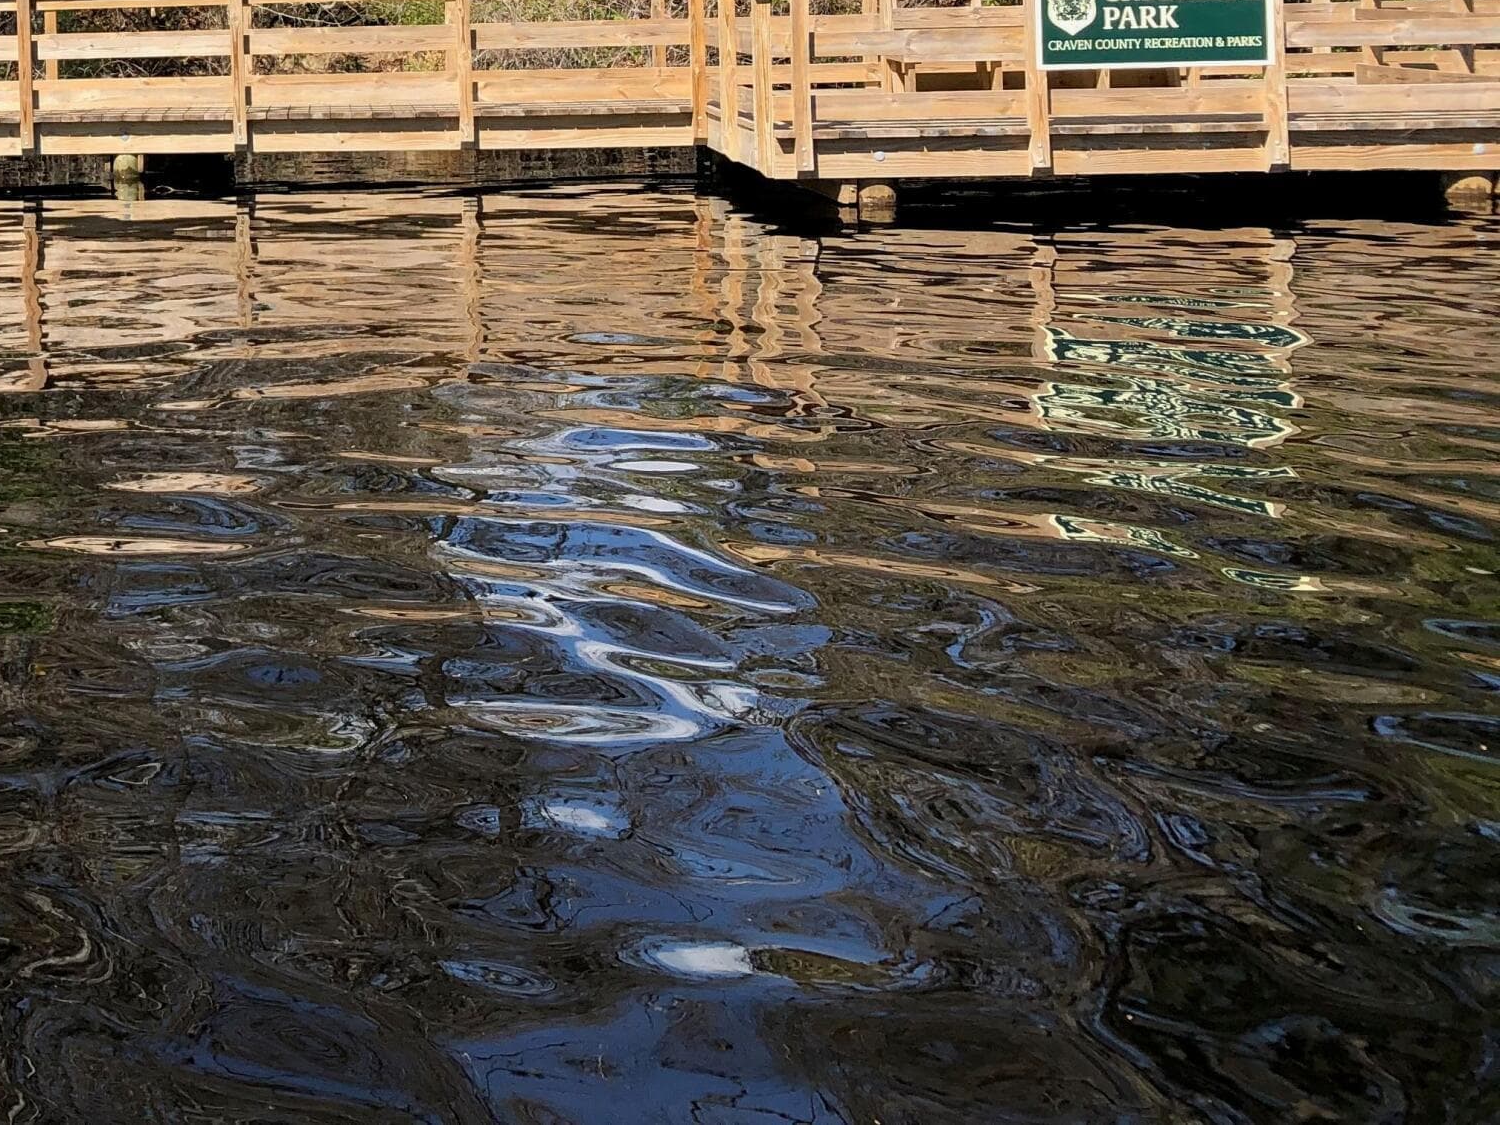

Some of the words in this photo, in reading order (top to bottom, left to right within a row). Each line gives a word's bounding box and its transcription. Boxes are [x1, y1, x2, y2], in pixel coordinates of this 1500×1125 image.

[1102, 5, 1179, 30] PARK
[1048, 40, 1092, 51] CRAVEN
[1094, 38, 1141, 49] COUNTY
[1144, 37, 1213, 48] RECREATION
[1215, 37, 1225, 47] &
[1227, 36, 1262, 47] PARKS
